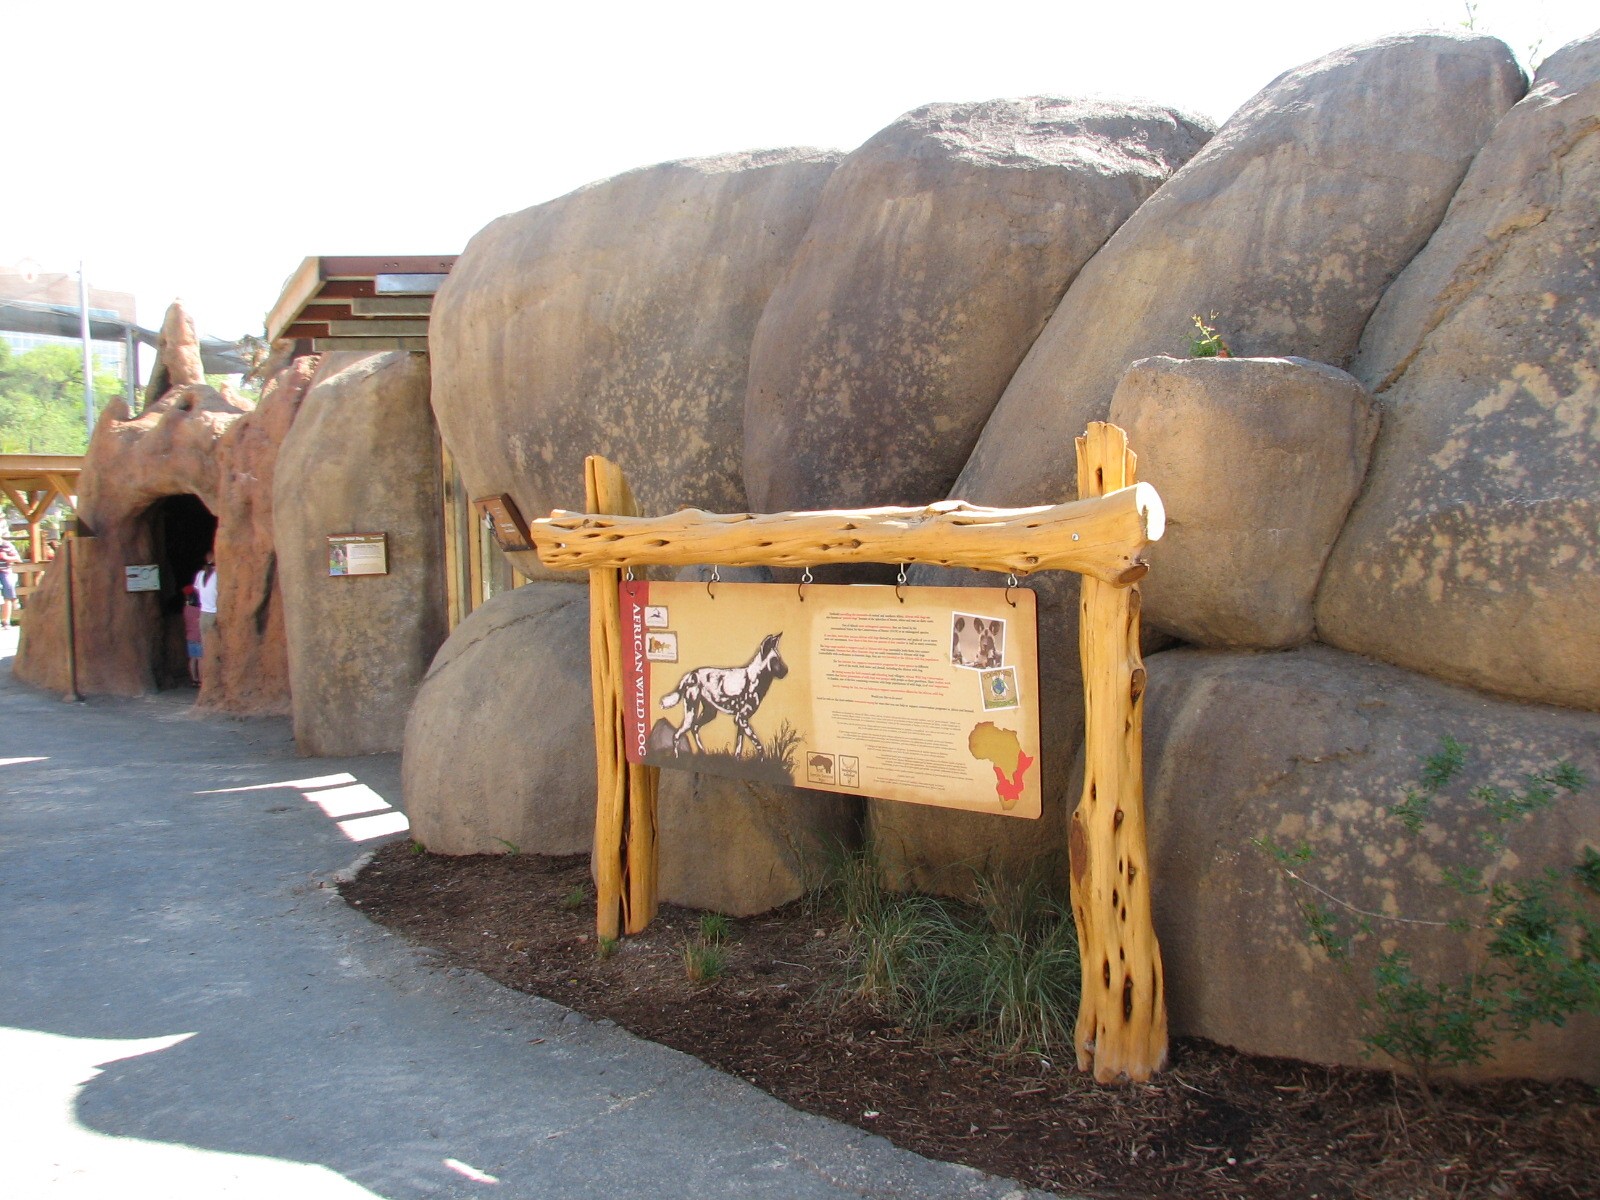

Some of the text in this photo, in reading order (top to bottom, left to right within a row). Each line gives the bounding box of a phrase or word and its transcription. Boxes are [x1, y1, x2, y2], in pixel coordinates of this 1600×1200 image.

[633, 603, 647, 756] AFRICAN WILD DOG
